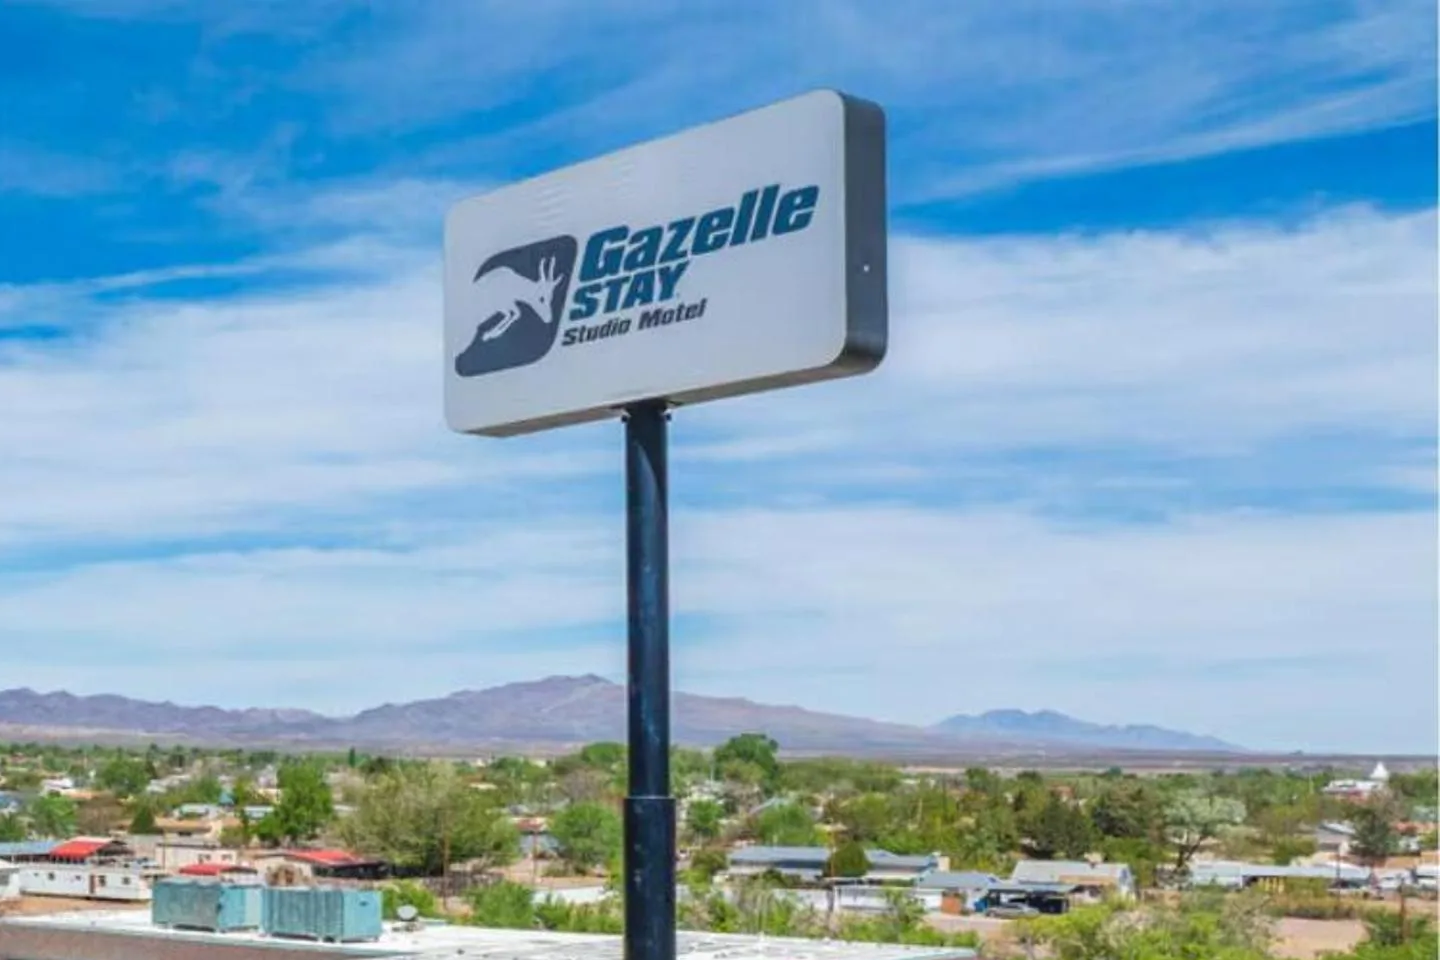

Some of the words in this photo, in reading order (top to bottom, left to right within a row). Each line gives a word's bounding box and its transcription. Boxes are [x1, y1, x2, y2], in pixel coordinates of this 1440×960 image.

[579, 184, 819, 282] Gazelle
[569, 261, 690, 320] STAY
[562, 318, 631, 346] Studio
[638, 299, 708, 331] Motel
